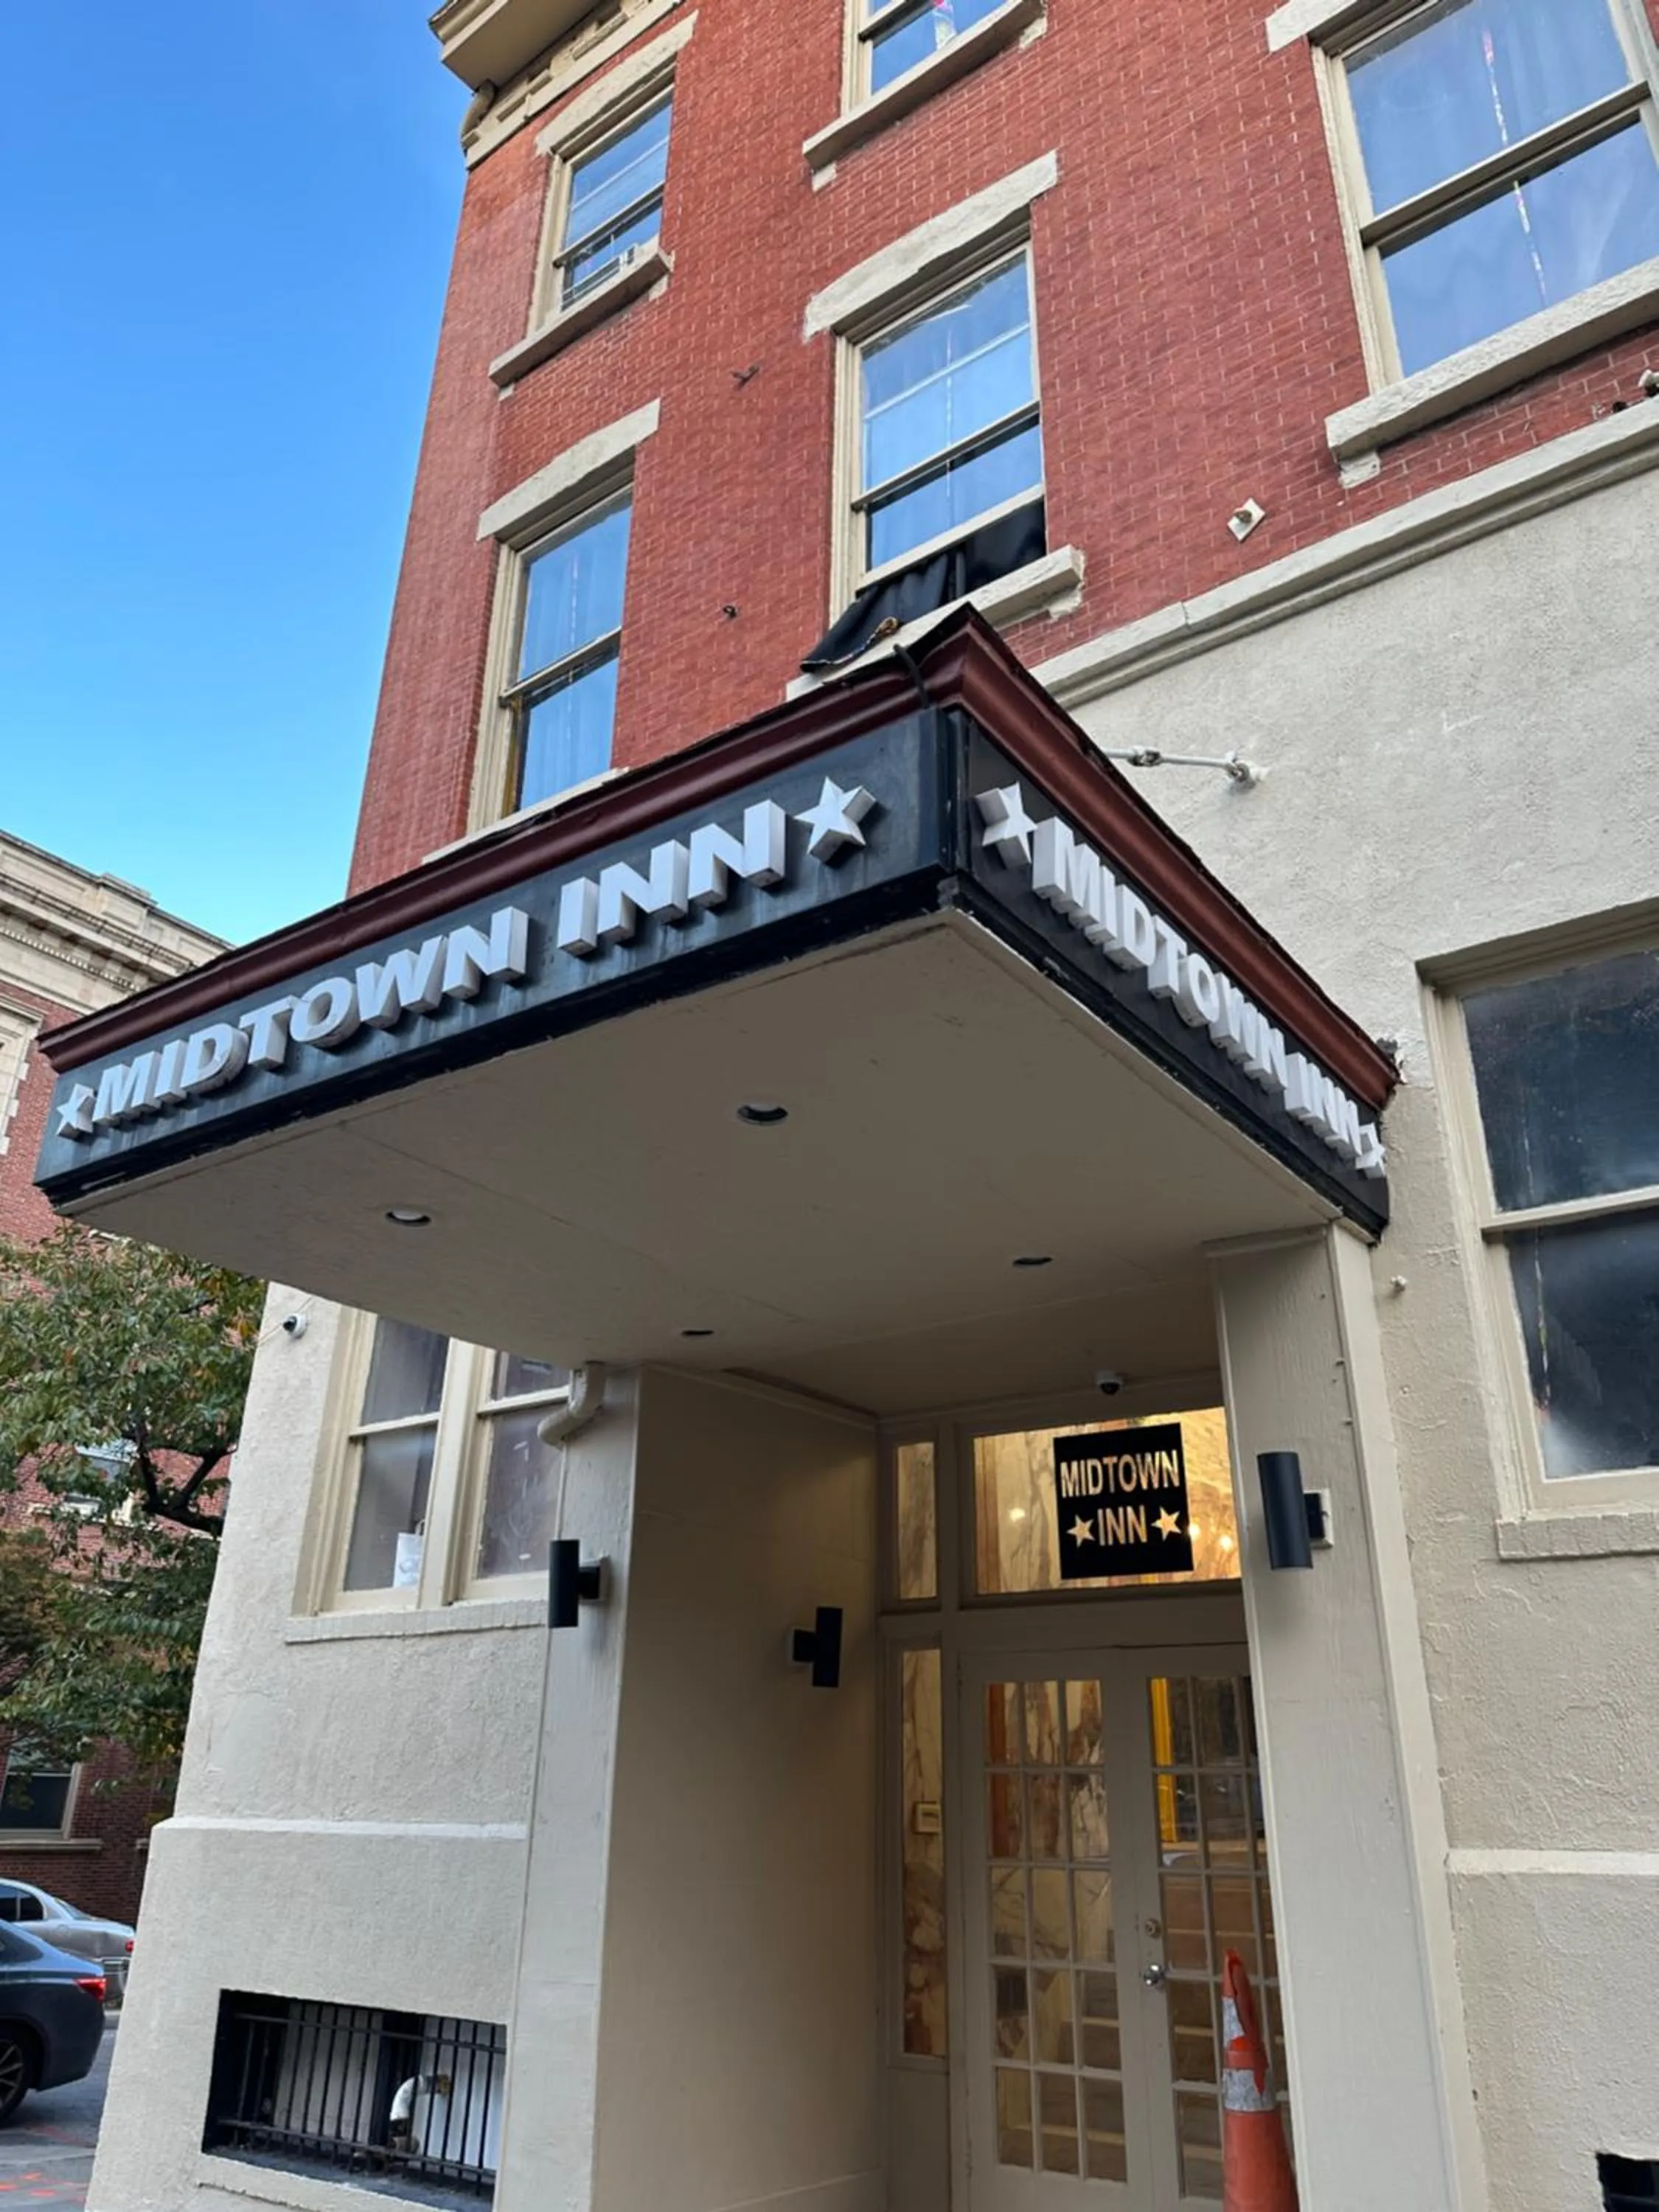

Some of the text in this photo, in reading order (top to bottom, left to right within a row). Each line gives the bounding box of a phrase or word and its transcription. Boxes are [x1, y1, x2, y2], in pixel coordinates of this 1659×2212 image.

[92, 799, 786, 1127] MIDTOWN INN
[1033, 815, 1362, 1162] MIDTOWN INN
[1060, 1450, 1180, 1498] MIDTOWN
[1097, 1504, 1147, 1546] INN
